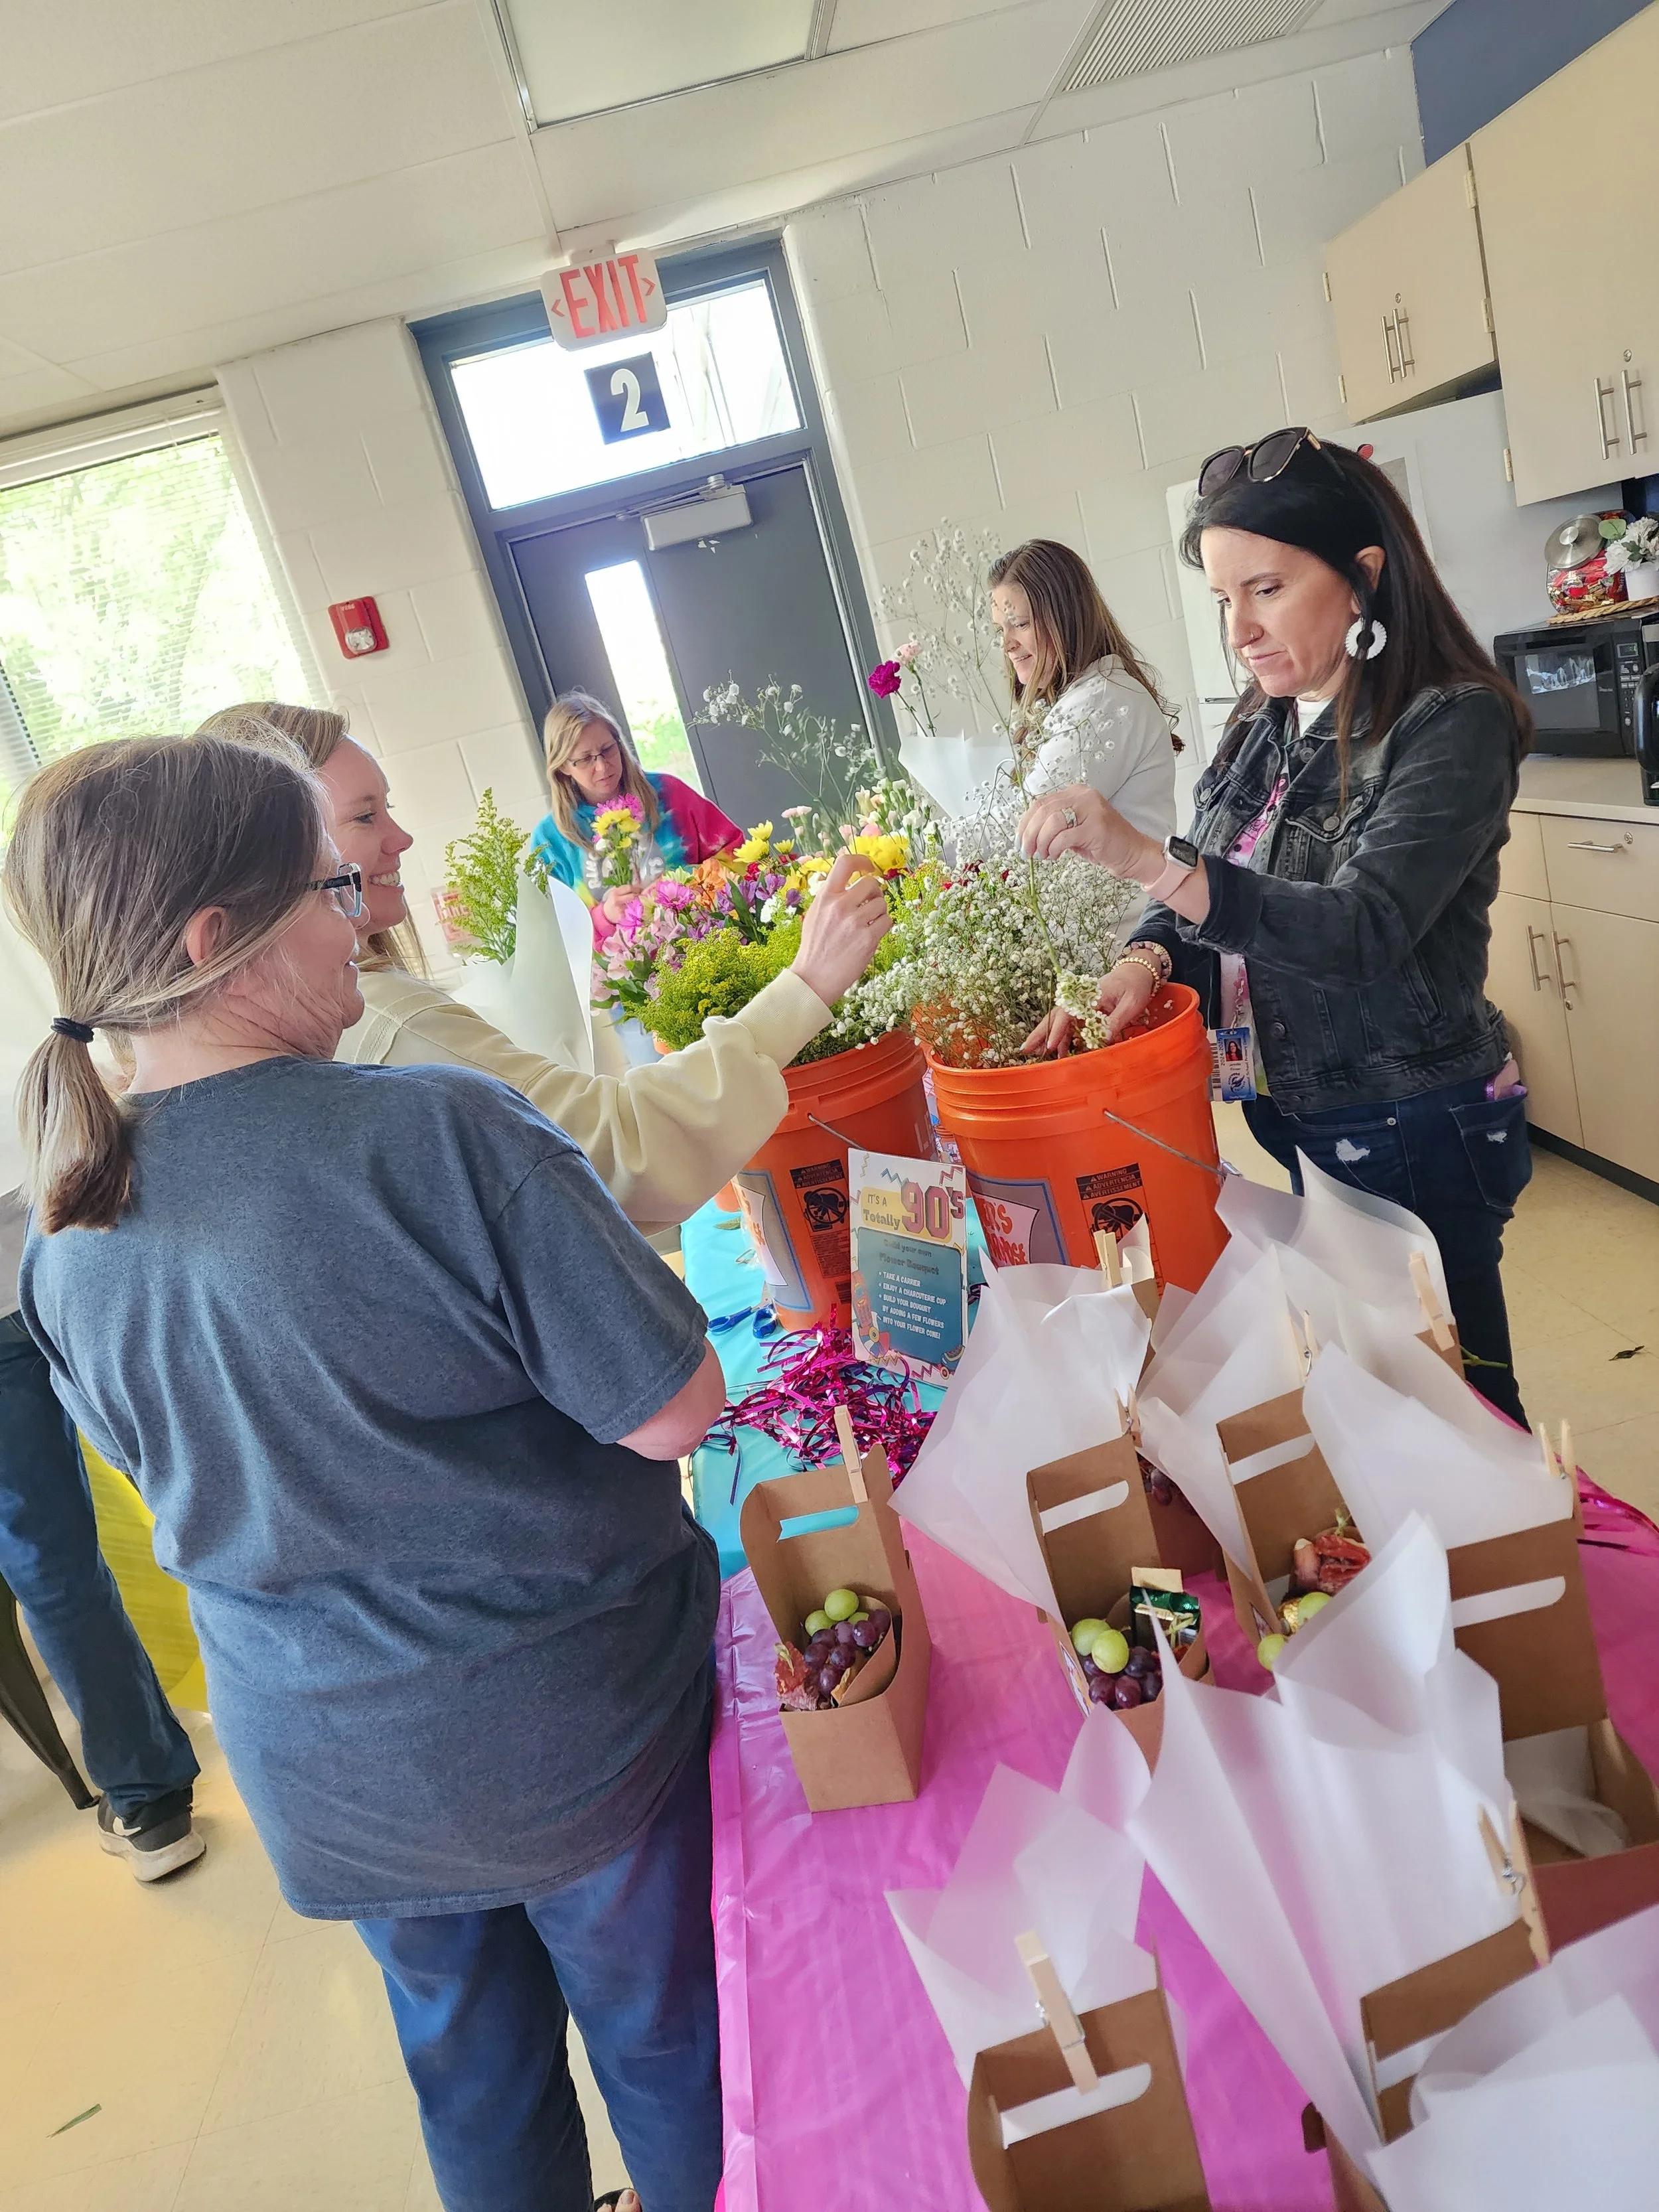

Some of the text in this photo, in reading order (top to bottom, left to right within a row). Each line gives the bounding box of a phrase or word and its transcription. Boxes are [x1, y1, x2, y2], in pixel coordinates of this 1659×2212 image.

[559, 254, 648, 338] EXIT
[611, 368, 649, 432] 2
[1093, 1174, 1135, 1190] ADVERTENCIA
[1096, 1168, 1127, 1181] WARNING
[1090, 1181, 1141, 1198] AVERTISSEMENT
[867, 1193, 887, 1207] IT'S A
[863, 1209, 901, 1230] Totally
[902, 1244, 916, 1254] your
[918, 1248, 932, 1258] own
[883, 1271, 895, 1281] TAKE
[901, 1276, 920, 1288] CARRIER
[883, 1282, 897, 1293] ENJOY
[903, 1288, 935, 1303] CHARCUTERIE
[936, 1297, 946, 1305] CUP
[883, 1294, 932, 1313] BUILD YOUR BOUQUET
[883, 1316, 893, 1325] INTO
[894, 1319, 906, 1329] YOUR
[906, 1323, 926, 1335] FLOWER
[890, 1307, 906, 1317] ADDING
[912, 1313, 922, 1322] FEW
[922, 1317, 944, 1329] FLOWERS
